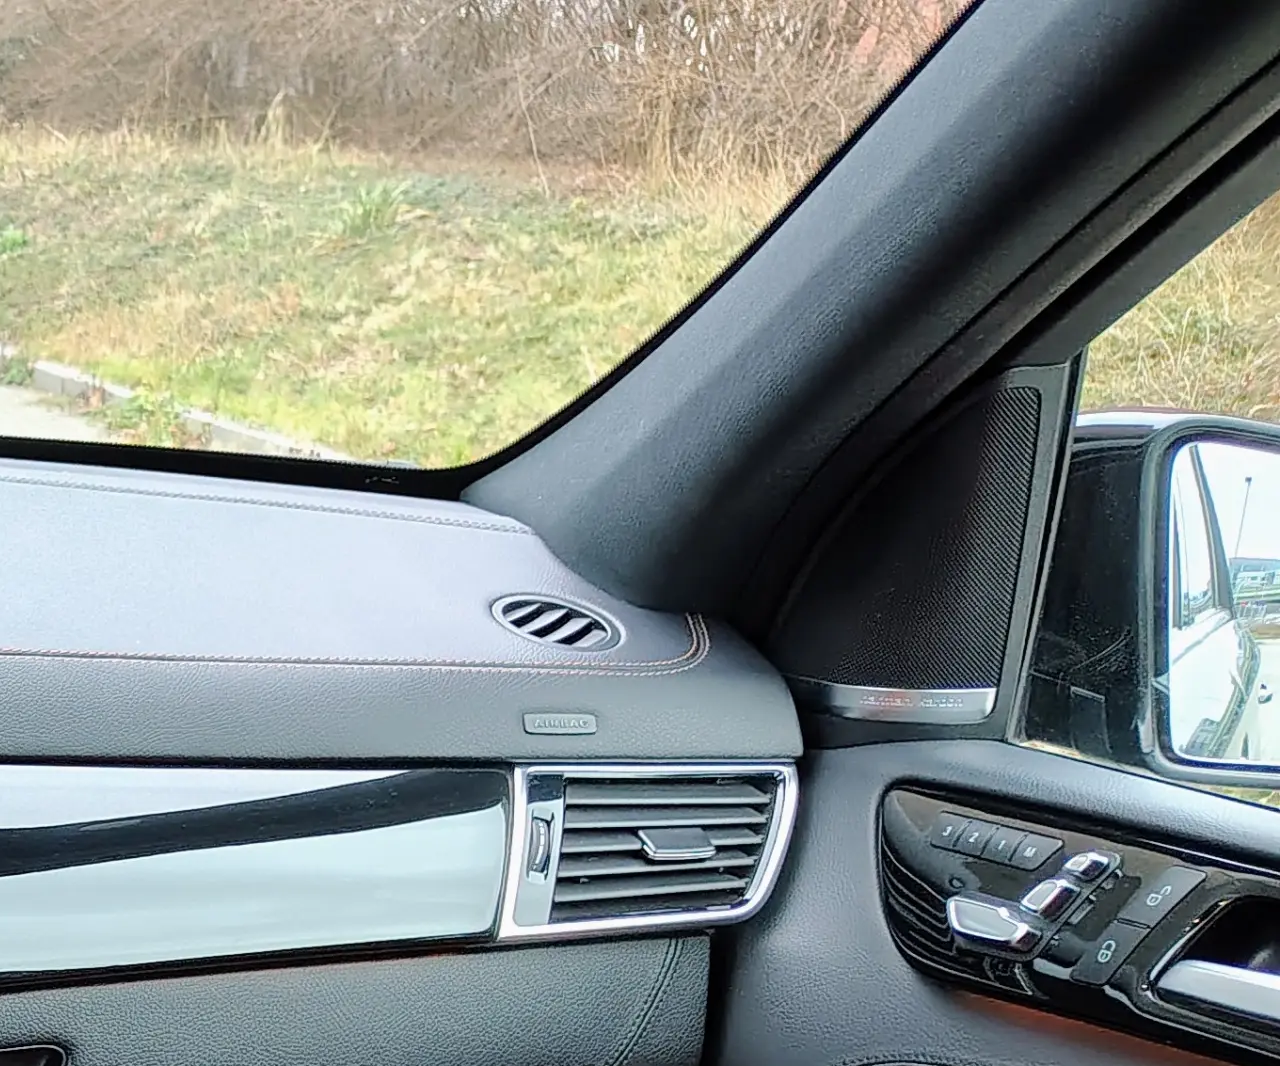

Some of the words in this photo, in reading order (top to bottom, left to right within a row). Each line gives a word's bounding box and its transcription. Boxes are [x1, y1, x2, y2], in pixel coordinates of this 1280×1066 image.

[942, 826, 953, 836] 3
[968, 832, 979, 843] 2
[998, 840, 1007, 850] 1
